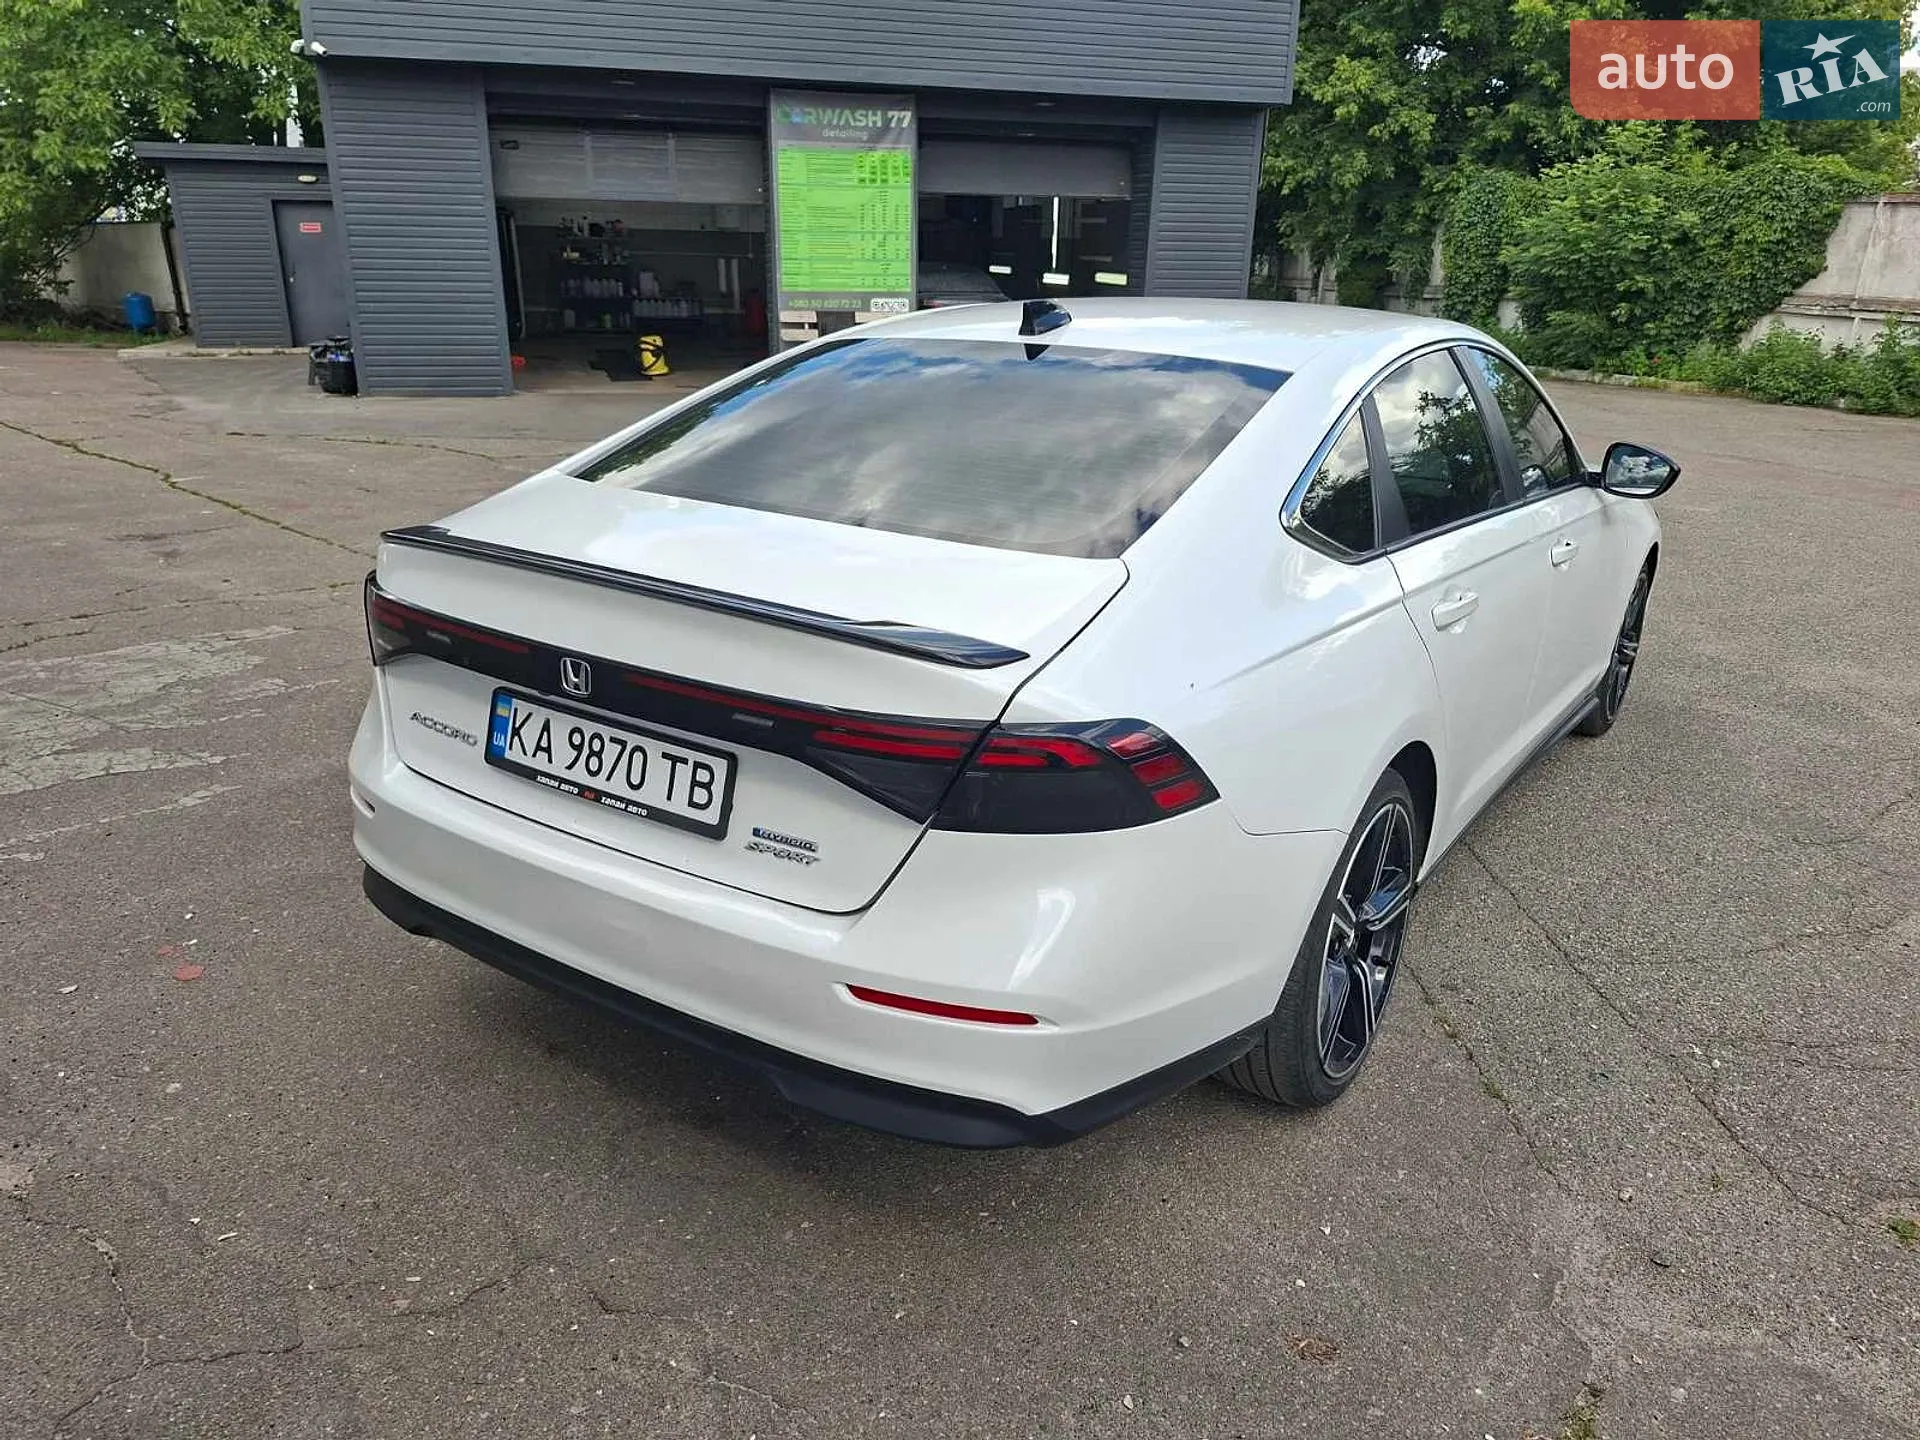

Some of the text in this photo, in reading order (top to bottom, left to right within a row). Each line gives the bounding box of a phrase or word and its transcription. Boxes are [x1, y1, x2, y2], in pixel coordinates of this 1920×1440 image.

[887, 110, 912, 128] 77
[409, 711, 478, 747] ACCORD
[493, 731, 505, 747] UA
[509, 707, 715, 810] KA 9870 TB
[744, 841, 821, 866] SPORT
